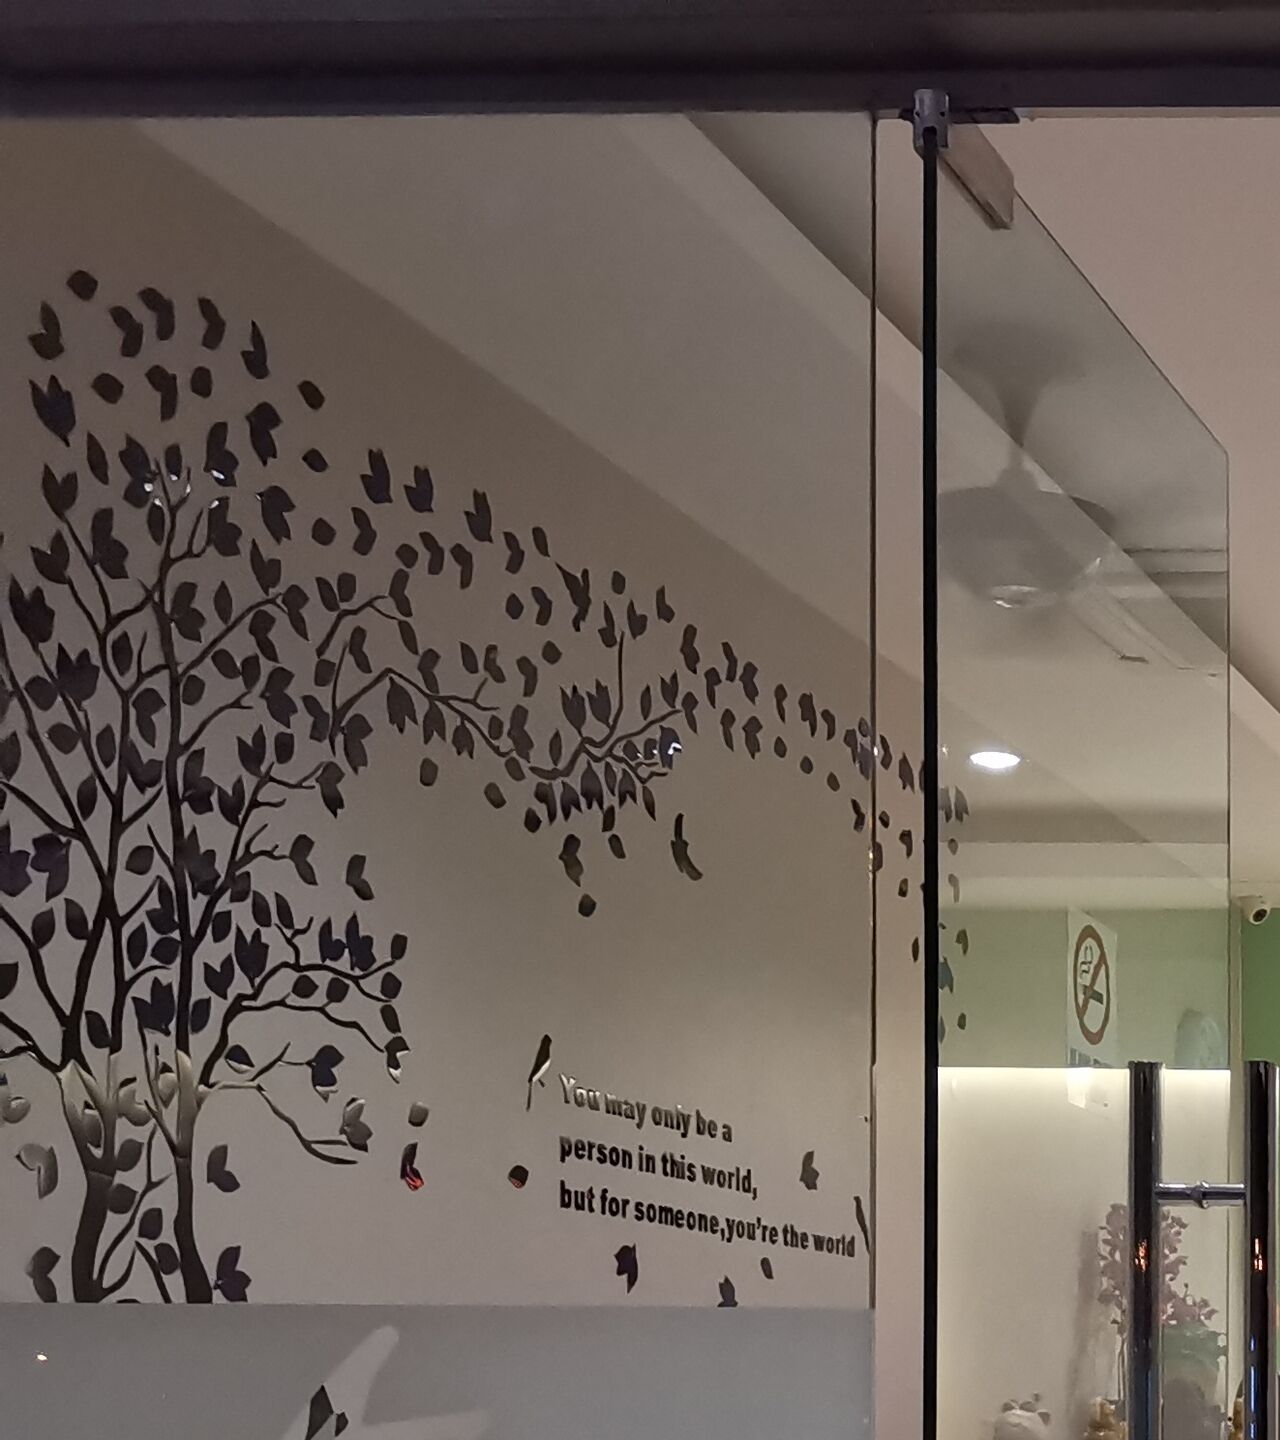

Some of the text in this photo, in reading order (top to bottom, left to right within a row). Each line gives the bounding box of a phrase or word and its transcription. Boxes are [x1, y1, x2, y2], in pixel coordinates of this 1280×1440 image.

[559, 1072, 733, 1143] You may only be a
[559, 1136, 758, 1201] person in this world,
[559, 1180, 596, 1214] but
[600, 1187, 630, 1219] for
[781, 1223, 809, 1250] the
[813, 1232, 856, 1258] world
